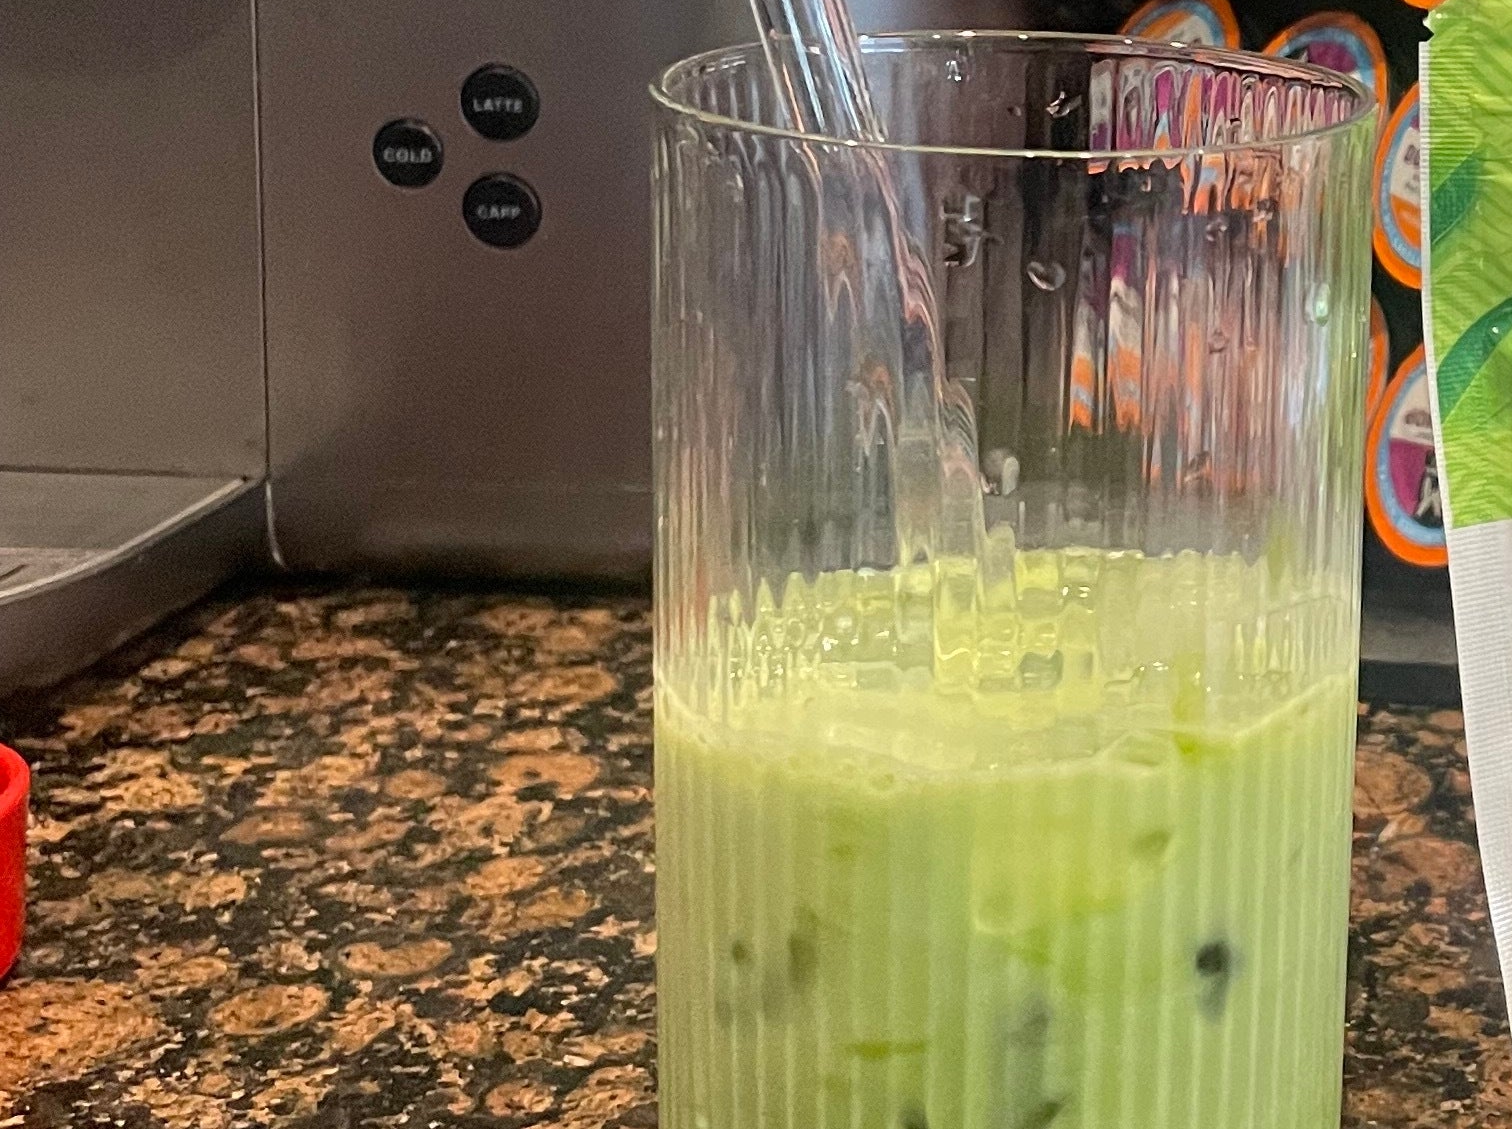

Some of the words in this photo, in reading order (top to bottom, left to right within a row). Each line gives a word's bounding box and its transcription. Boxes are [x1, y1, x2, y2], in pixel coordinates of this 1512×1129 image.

[472, 98, 523, 113] LATTE
[382, 147, 433, 163] COLD
[475, 205, 521, 220] CAPP
